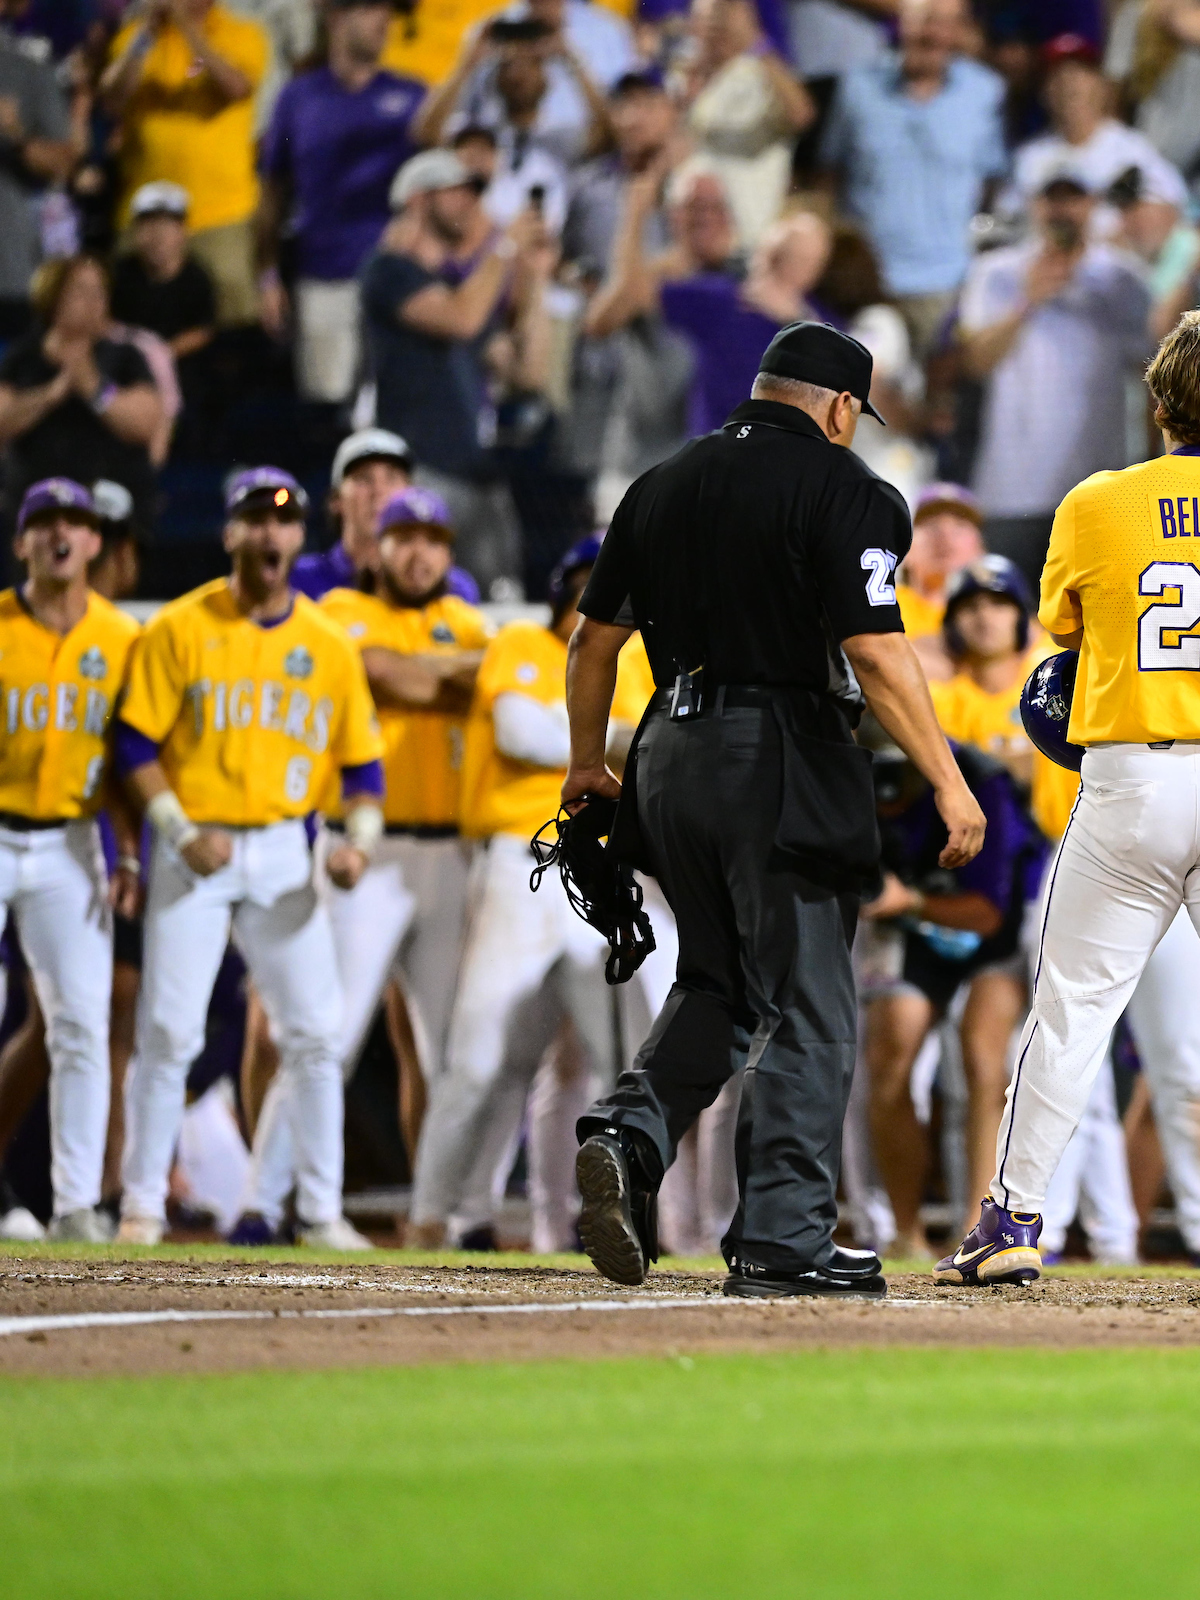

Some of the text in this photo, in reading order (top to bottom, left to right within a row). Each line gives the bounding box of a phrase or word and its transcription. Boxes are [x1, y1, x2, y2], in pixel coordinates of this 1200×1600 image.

[860, 548, 898, 606] 2
[184, 677, 334, 756] TIGERS
[284, 756, 312, 804] 6
